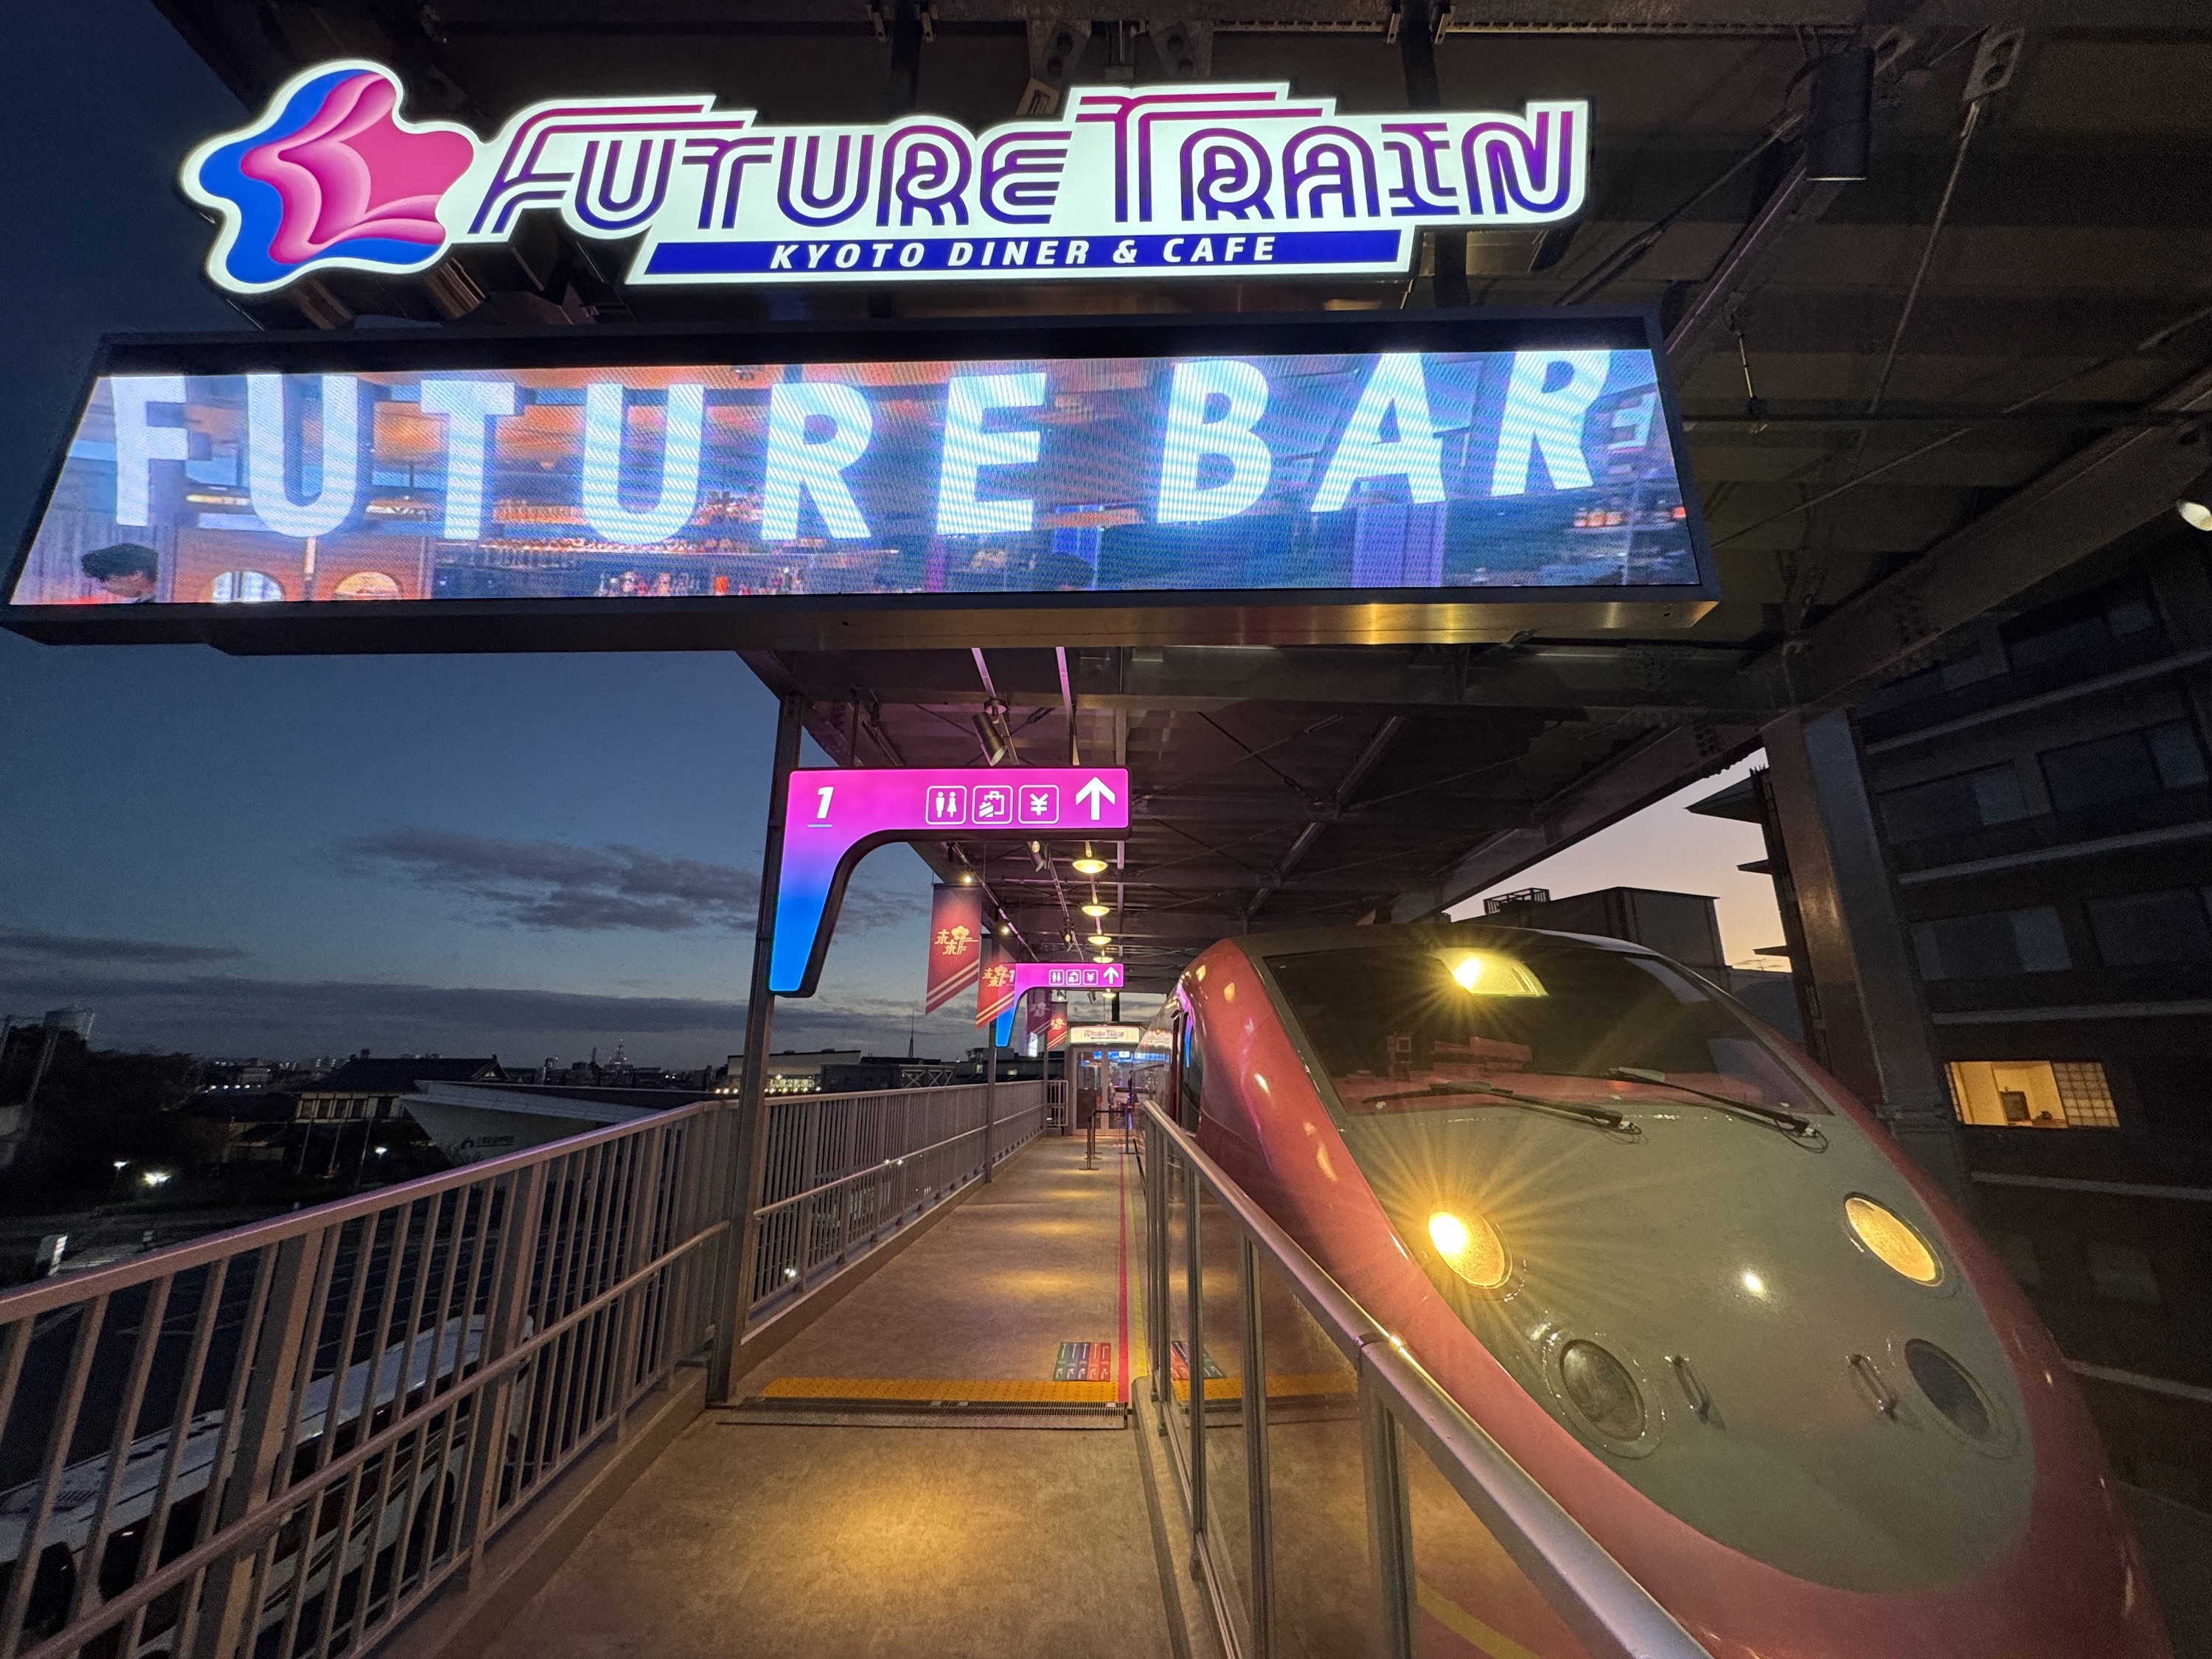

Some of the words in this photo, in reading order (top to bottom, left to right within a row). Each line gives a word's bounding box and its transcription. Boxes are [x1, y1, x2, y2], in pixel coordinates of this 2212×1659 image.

[467, 103, 1072, 234] FUTURE
[1075, 91, 1573, 223] TRAIN
[770, 243, 925, 269] KYOTO
[947, 240, 1090, 267] DINER
[1113, 240, 1137, 263] &
[1163, 236, 1276, 263] CAFE
[111, 372, 1046, 544] FUTURE
[1158, 350, 1612, 524] BAR
[816, 787, 834, 819] 1
